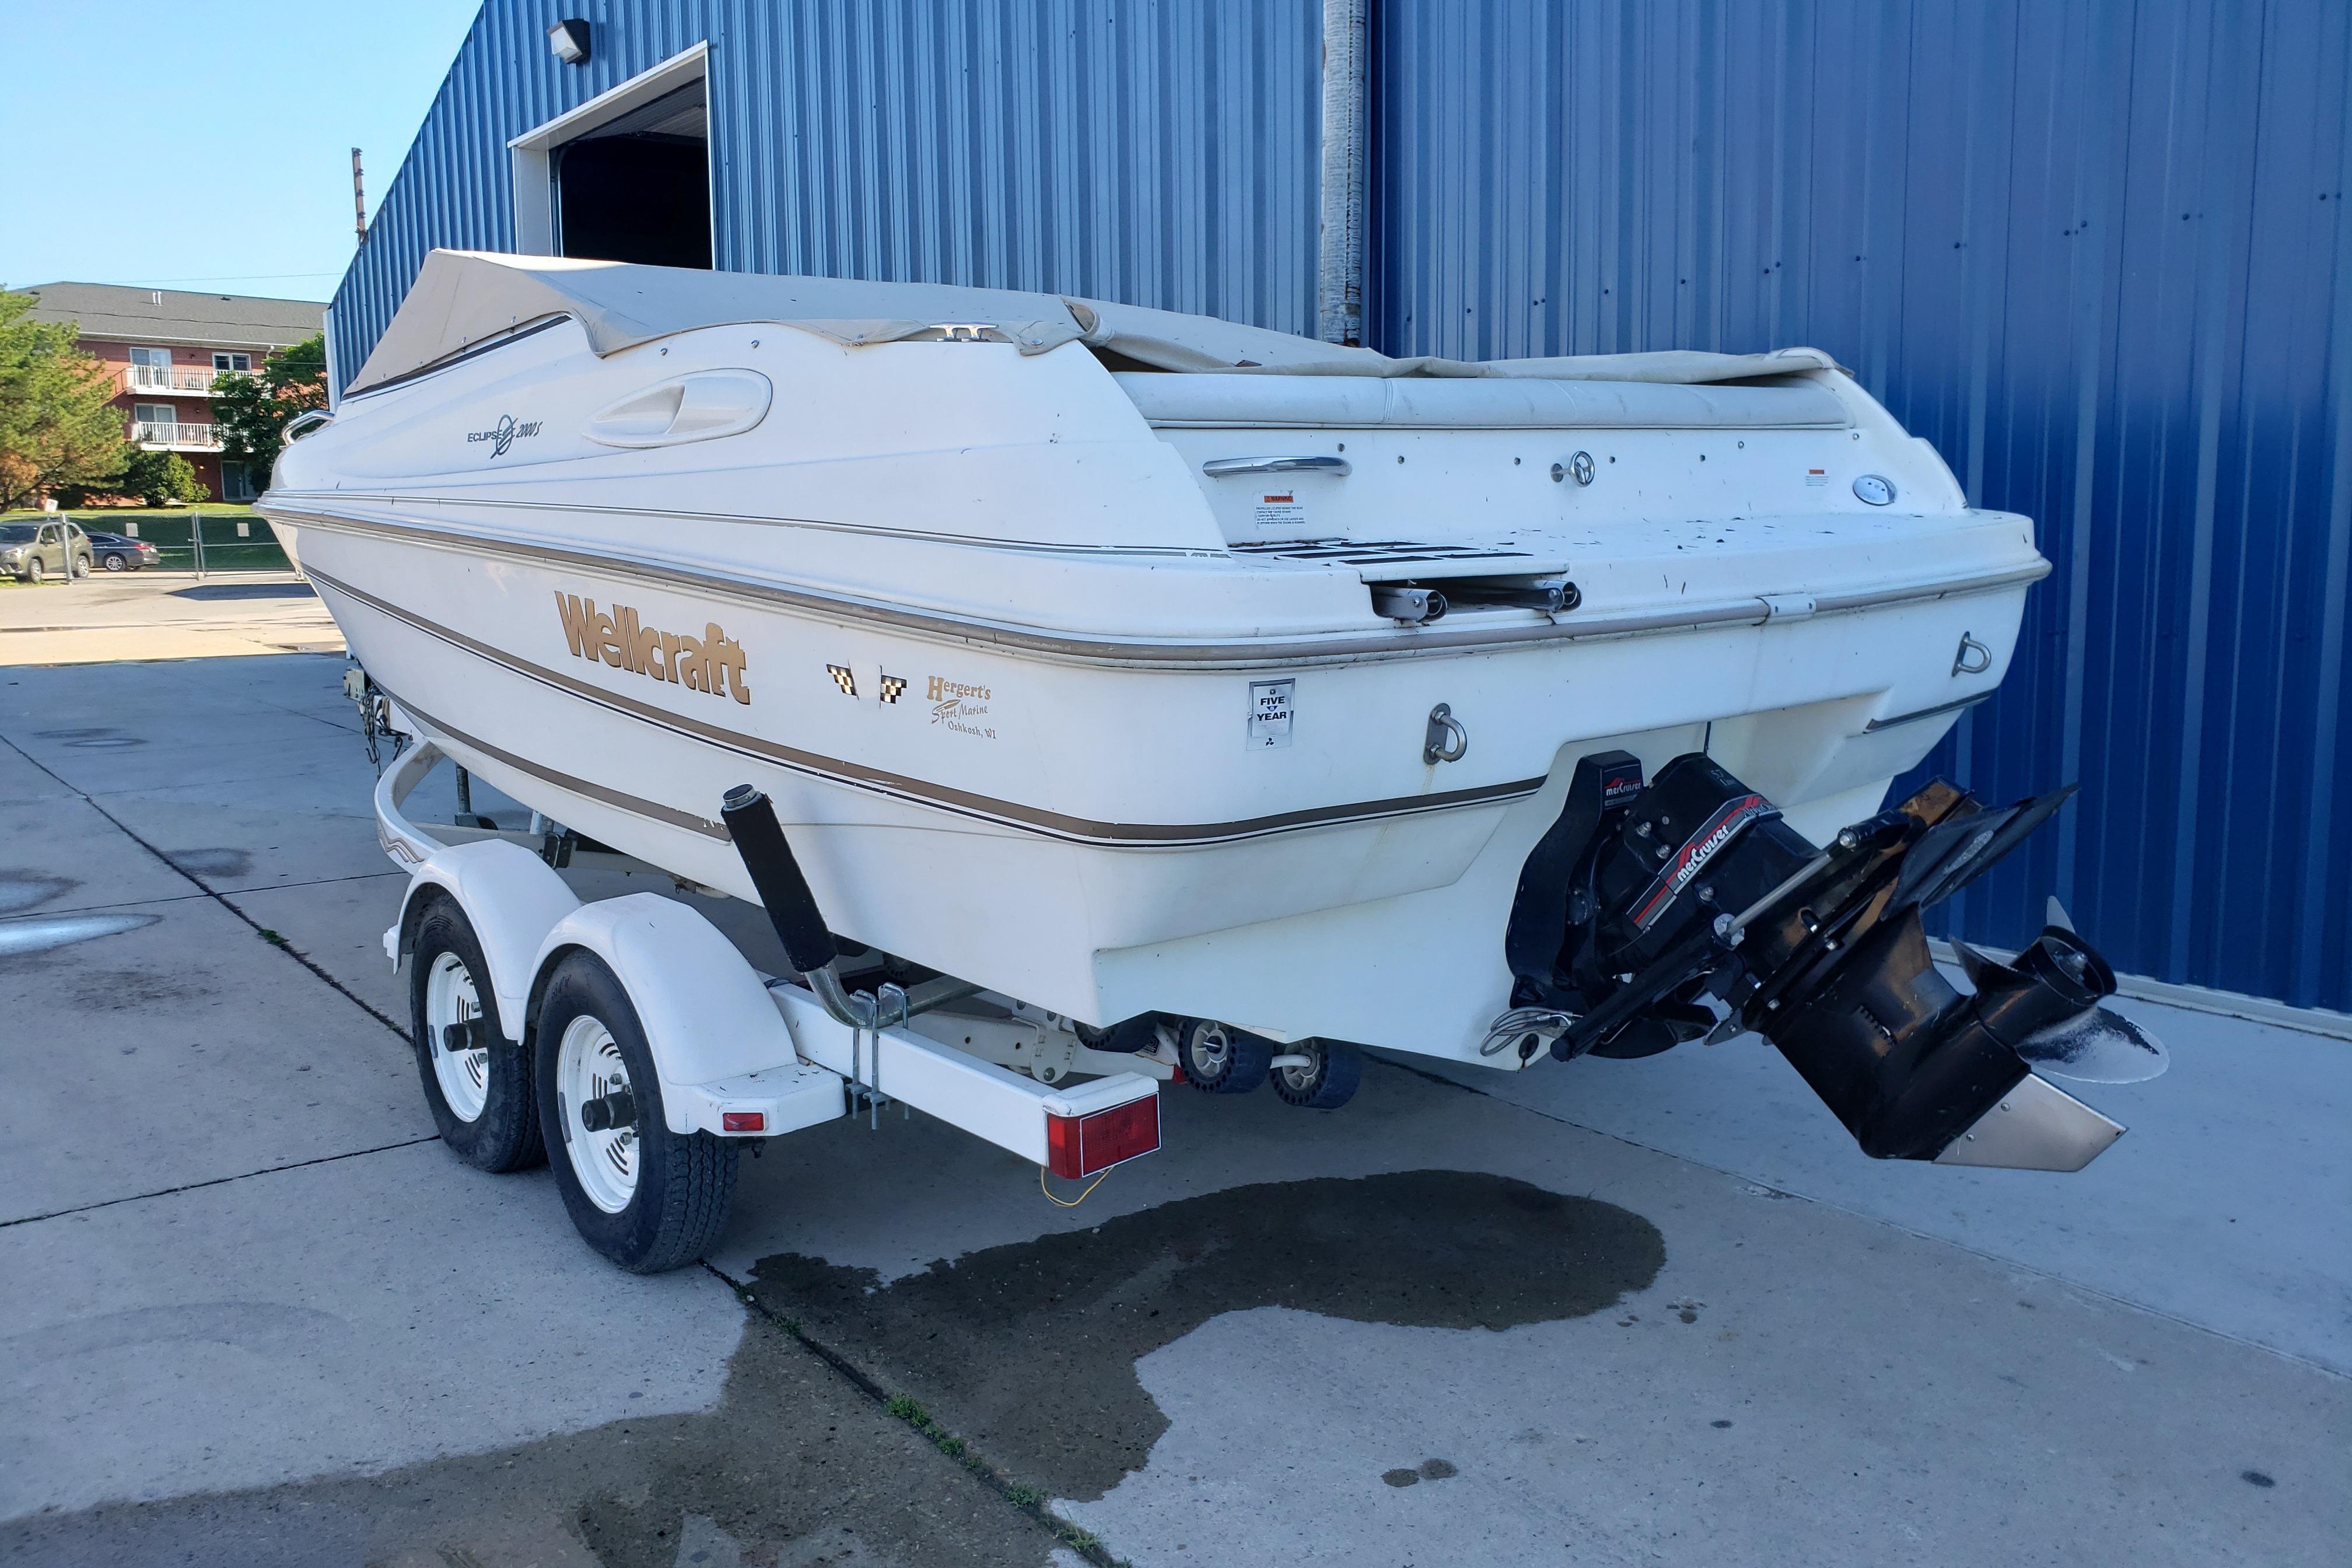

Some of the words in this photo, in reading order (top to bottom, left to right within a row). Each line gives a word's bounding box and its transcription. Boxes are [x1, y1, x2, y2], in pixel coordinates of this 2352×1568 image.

[467, 429, 503, 442] ECLIPSE
[555, 590, 751, 705] Wellcraft
[927, 676, 991, 702] Hergert's
[1260, 696, 1285, 706] FIVE
[932, 704, 957, 724] Sport
[958, 704, 988, 719] Marine
[1256, 711, 1287, 721] YEAR
[948, 720, 984, 738] Oshkosh,
[984, 728, 996, 739] WI
